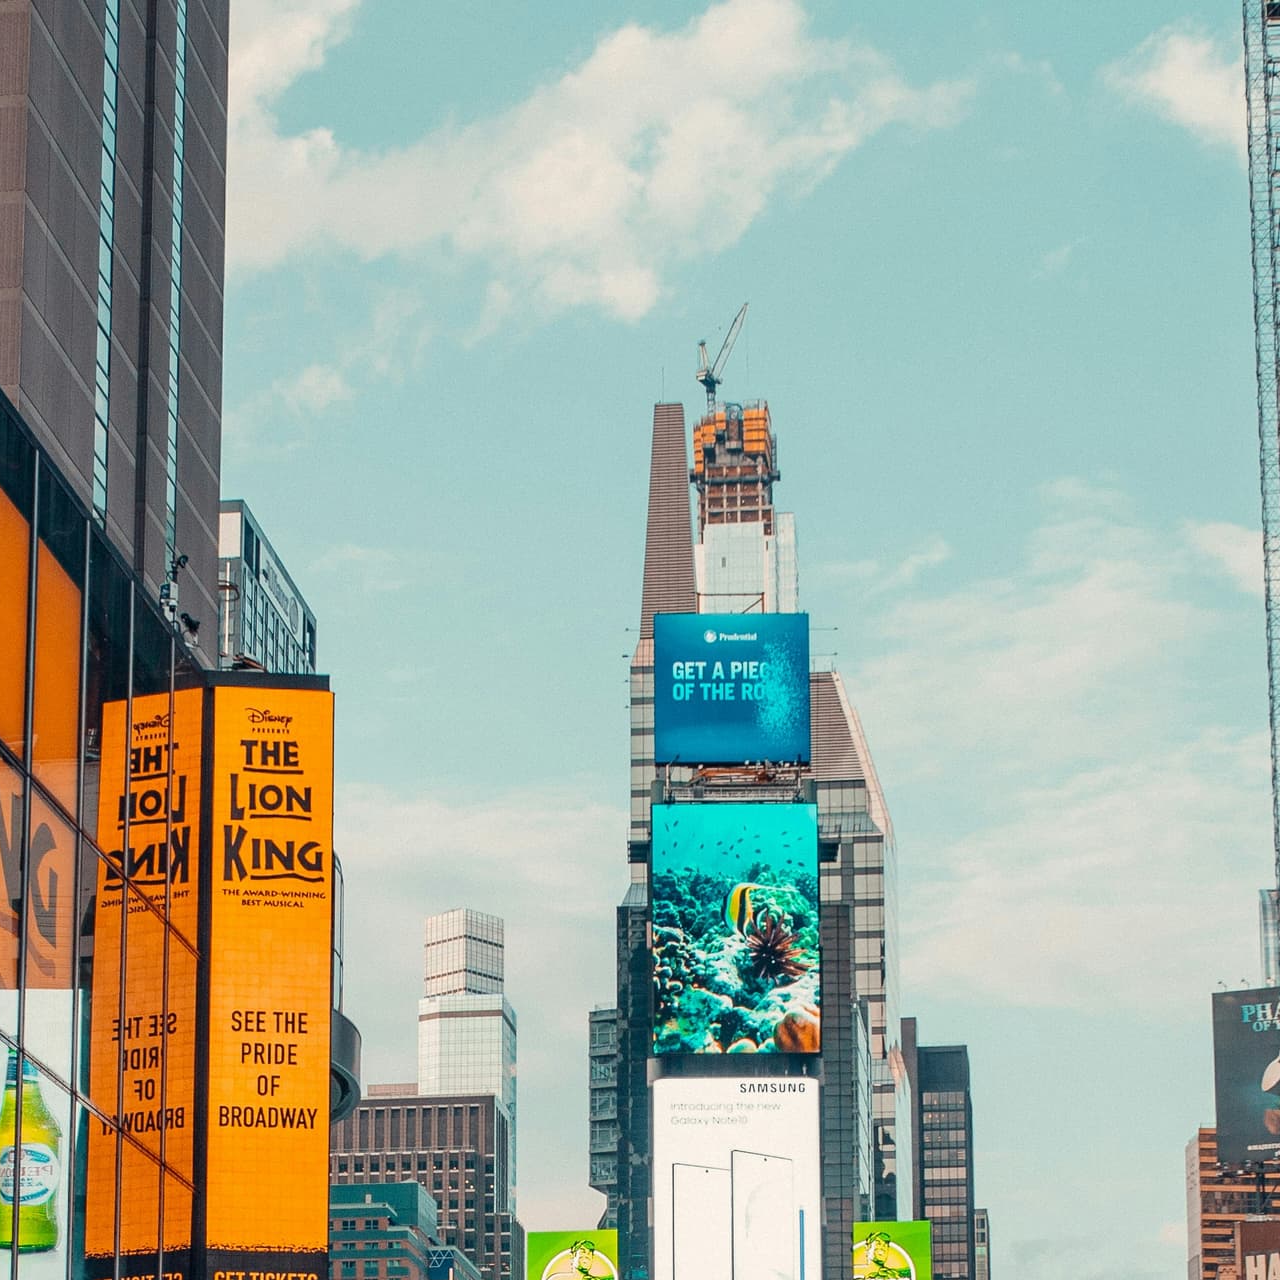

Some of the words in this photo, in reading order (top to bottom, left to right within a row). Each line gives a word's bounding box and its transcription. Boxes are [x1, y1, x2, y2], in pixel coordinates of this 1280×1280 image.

[719, 632, 757, 642] Prudential
[673, 661, 707, 681] GET
[712, 662, 725, 680] A
[730, 662, 770, 680] PIEC
[673, 682, 695, 702] OF
[699, 682, 735, 701] THE
[245, 707, 293, 727] Disney
[240, 740, 299, 767] THE
[230, 774, 312, 821] LION
[223, 825, 324, 882] KING
[222, 888, 241, 897] THE
[243, 889, 326, 900] AWARD-WINNING
[241, 899, 262, 907] BEST
[265, 900, 304, 908] MUSICAL
[231, 1011, 267, 1033] SEE
[274, 1011, 308, 1034] THE
[241, 1043, 298, 1066] PRIDE
[257, 1074, 280, 1097] OF
[740, 1083, 806, 1093] SAMSUNG
[219, 1106, 318, 1129] BROADWAY
[671, 1102, 734, 1114] Introducing
[736, 1101, 754, 1111] the
[671, 1115, 710, 1126] Galaxy
